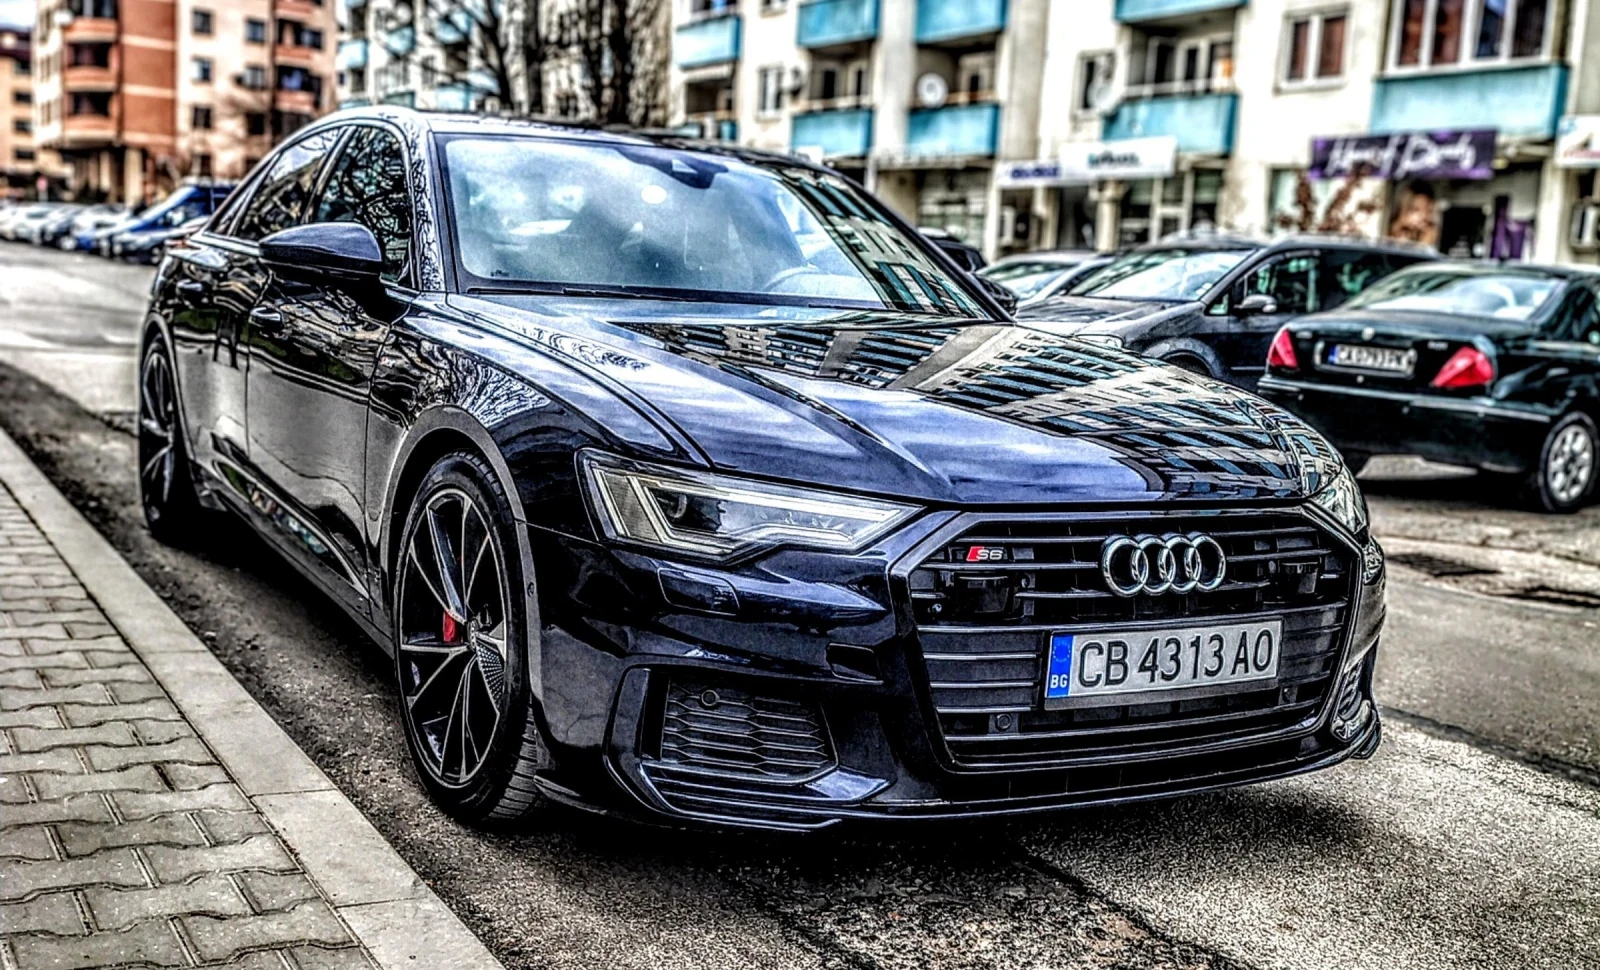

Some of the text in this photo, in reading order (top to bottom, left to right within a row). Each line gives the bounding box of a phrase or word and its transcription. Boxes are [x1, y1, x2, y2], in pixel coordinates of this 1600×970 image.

[975, 549, 1004, 560] S6
[1078, 640, 1129, 688] CB
[1137, 633, 1226, 683] 4313
[1049, 673, 1068, 689] BG
